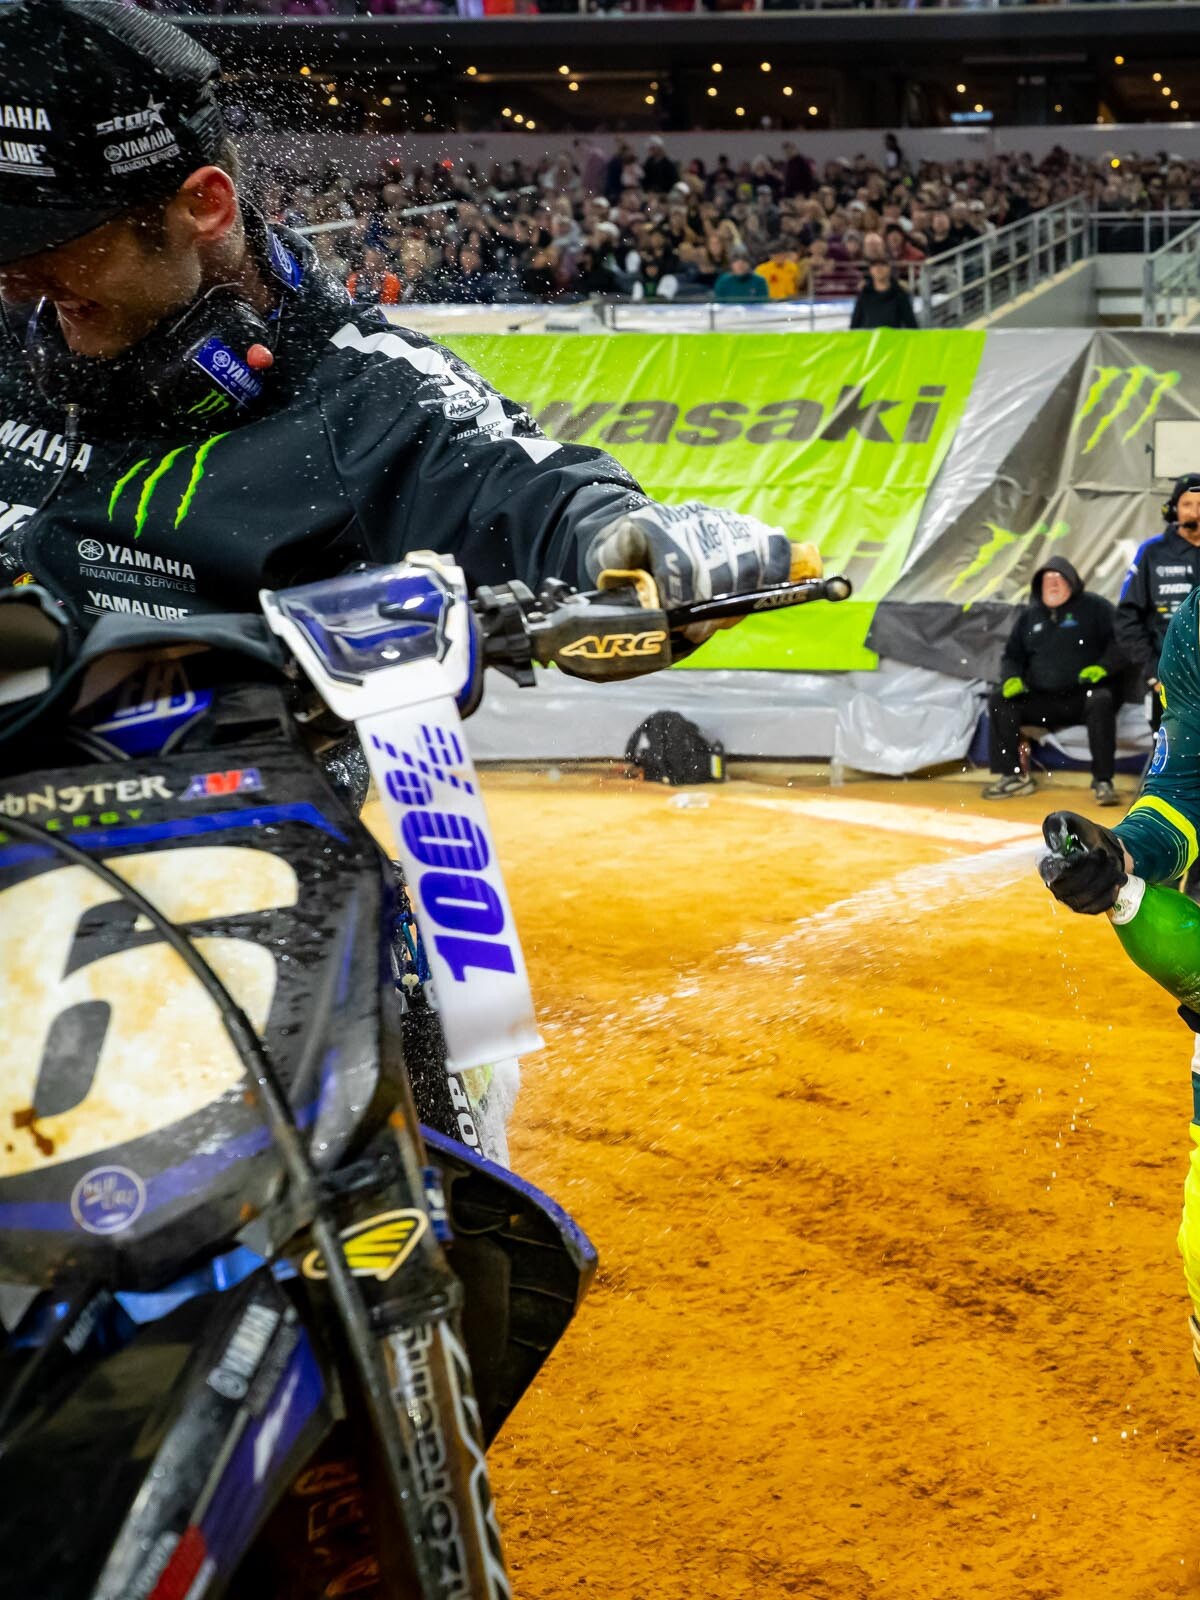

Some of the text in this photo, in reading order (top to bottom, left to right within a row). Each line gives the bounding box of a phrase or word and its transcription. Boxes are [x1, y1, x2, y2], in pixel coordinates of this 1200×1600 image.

[120, 128, 175, 158] YAMAHA
[0, 419, 93, 472] MAHA
[106, 543, 196, 580] YAMAHA
[79, 566, 196, 593] FINANCIAL SERVICES
[1158, 583, 1192, 595] THOR
[88, 590, 189, 622] YAMALUBE
[559, 630, 666, 659] ARC
[0, 775, 173, 817] ONSTER
[371, 724, 516, 982] 100%
[0, 846, 298, 1178] 6
